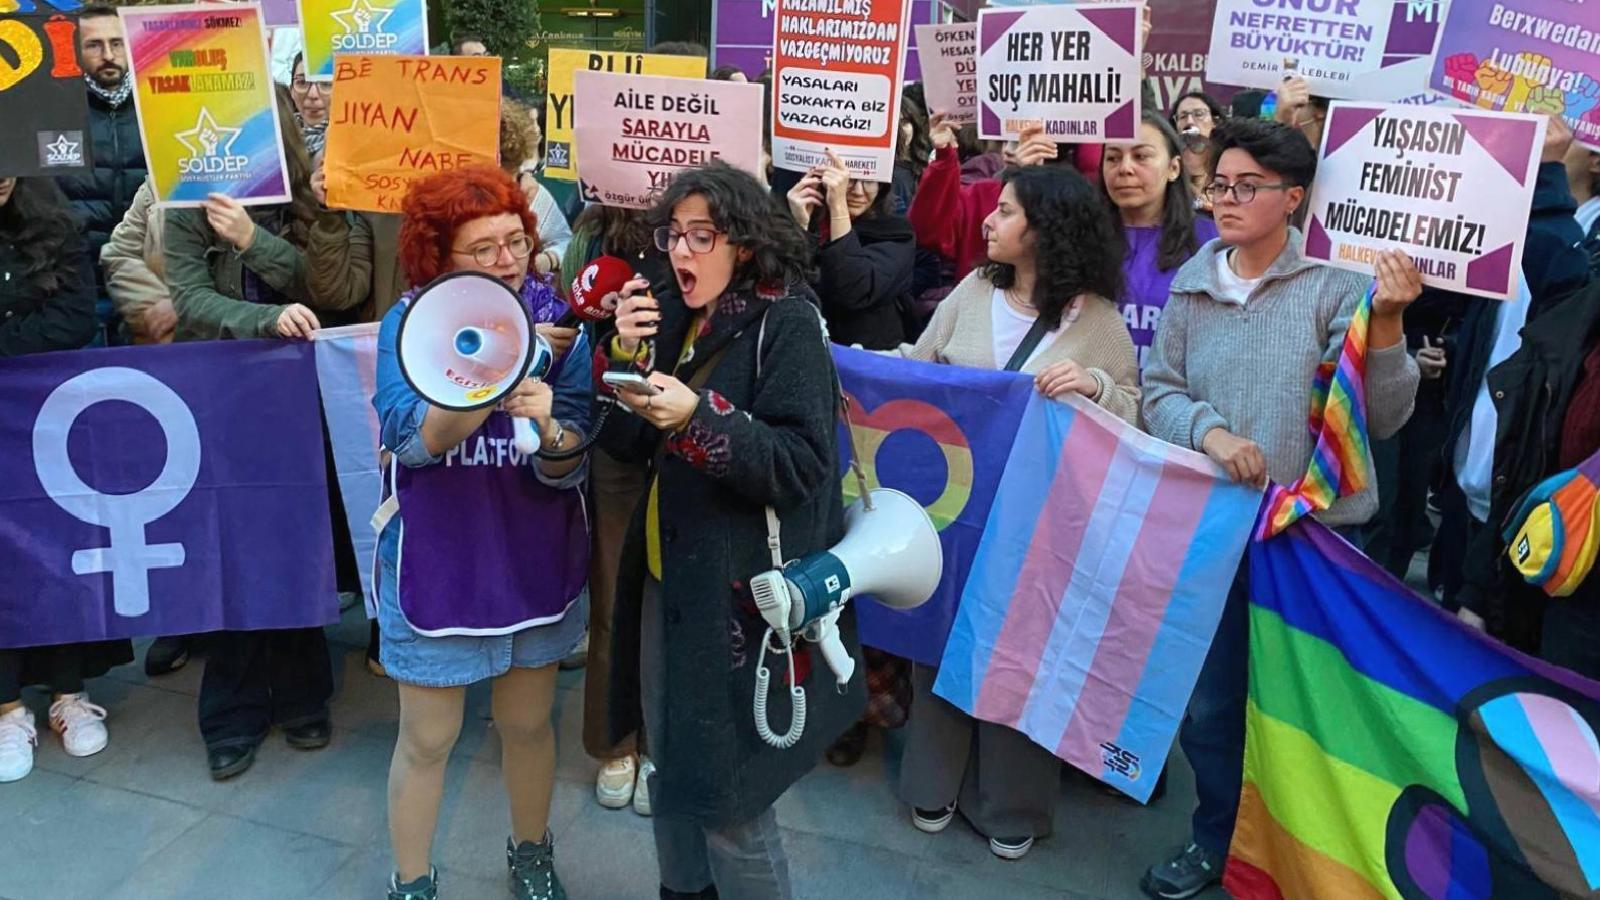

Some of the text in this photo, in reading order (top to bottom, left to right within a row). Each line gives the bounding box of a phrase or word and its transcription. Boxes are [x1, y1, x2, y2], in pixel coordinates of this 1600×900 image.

[781, 15, 898, 42] HAKLARIMIZDAN
[935, 29, 976, 43] ÖFKEN
[1229, 11, 1373, 42] NEFRETTEN
[331, 32, 398, 50] SOLDEP
[780, 40, 891, 66] VAZGEÇMİYORUZ
[1007, 31, 1091, 62] HER YER
[1230, 29, 1365, 62] BÜYÜKTÜR!
[335, 57, 488, 85] BÊ TRANS
[782, 74, 858, 92] YASALARI
[1242, 60, 1351, 81] DEMİR LEBLEBİ
[1489, 48, 1585, 94] Lubunya!
[614, 88, 720, 115] AİLE DEĞİL
[781, 93, 886, 112] SOKAKTA BİZ
[989, 67, 1121, 112] SUÇ MAHALİ!
[335, 101, 419, 134] JIYAN
[622, 117, 711, 142] SARAYLA
[780, 111, 871, 131] YAZACAĞIZ!
[1045, 119, 1097, 136] KADINLAR
[1373, 117, 1467, 159] YAŞASIN
[177, 154, 249, 173] SOLDEP
[1359, 159, 1463, 203] FEMİNİST
[1324, 198, 1486, 255] MÜCADELEMİZ!
